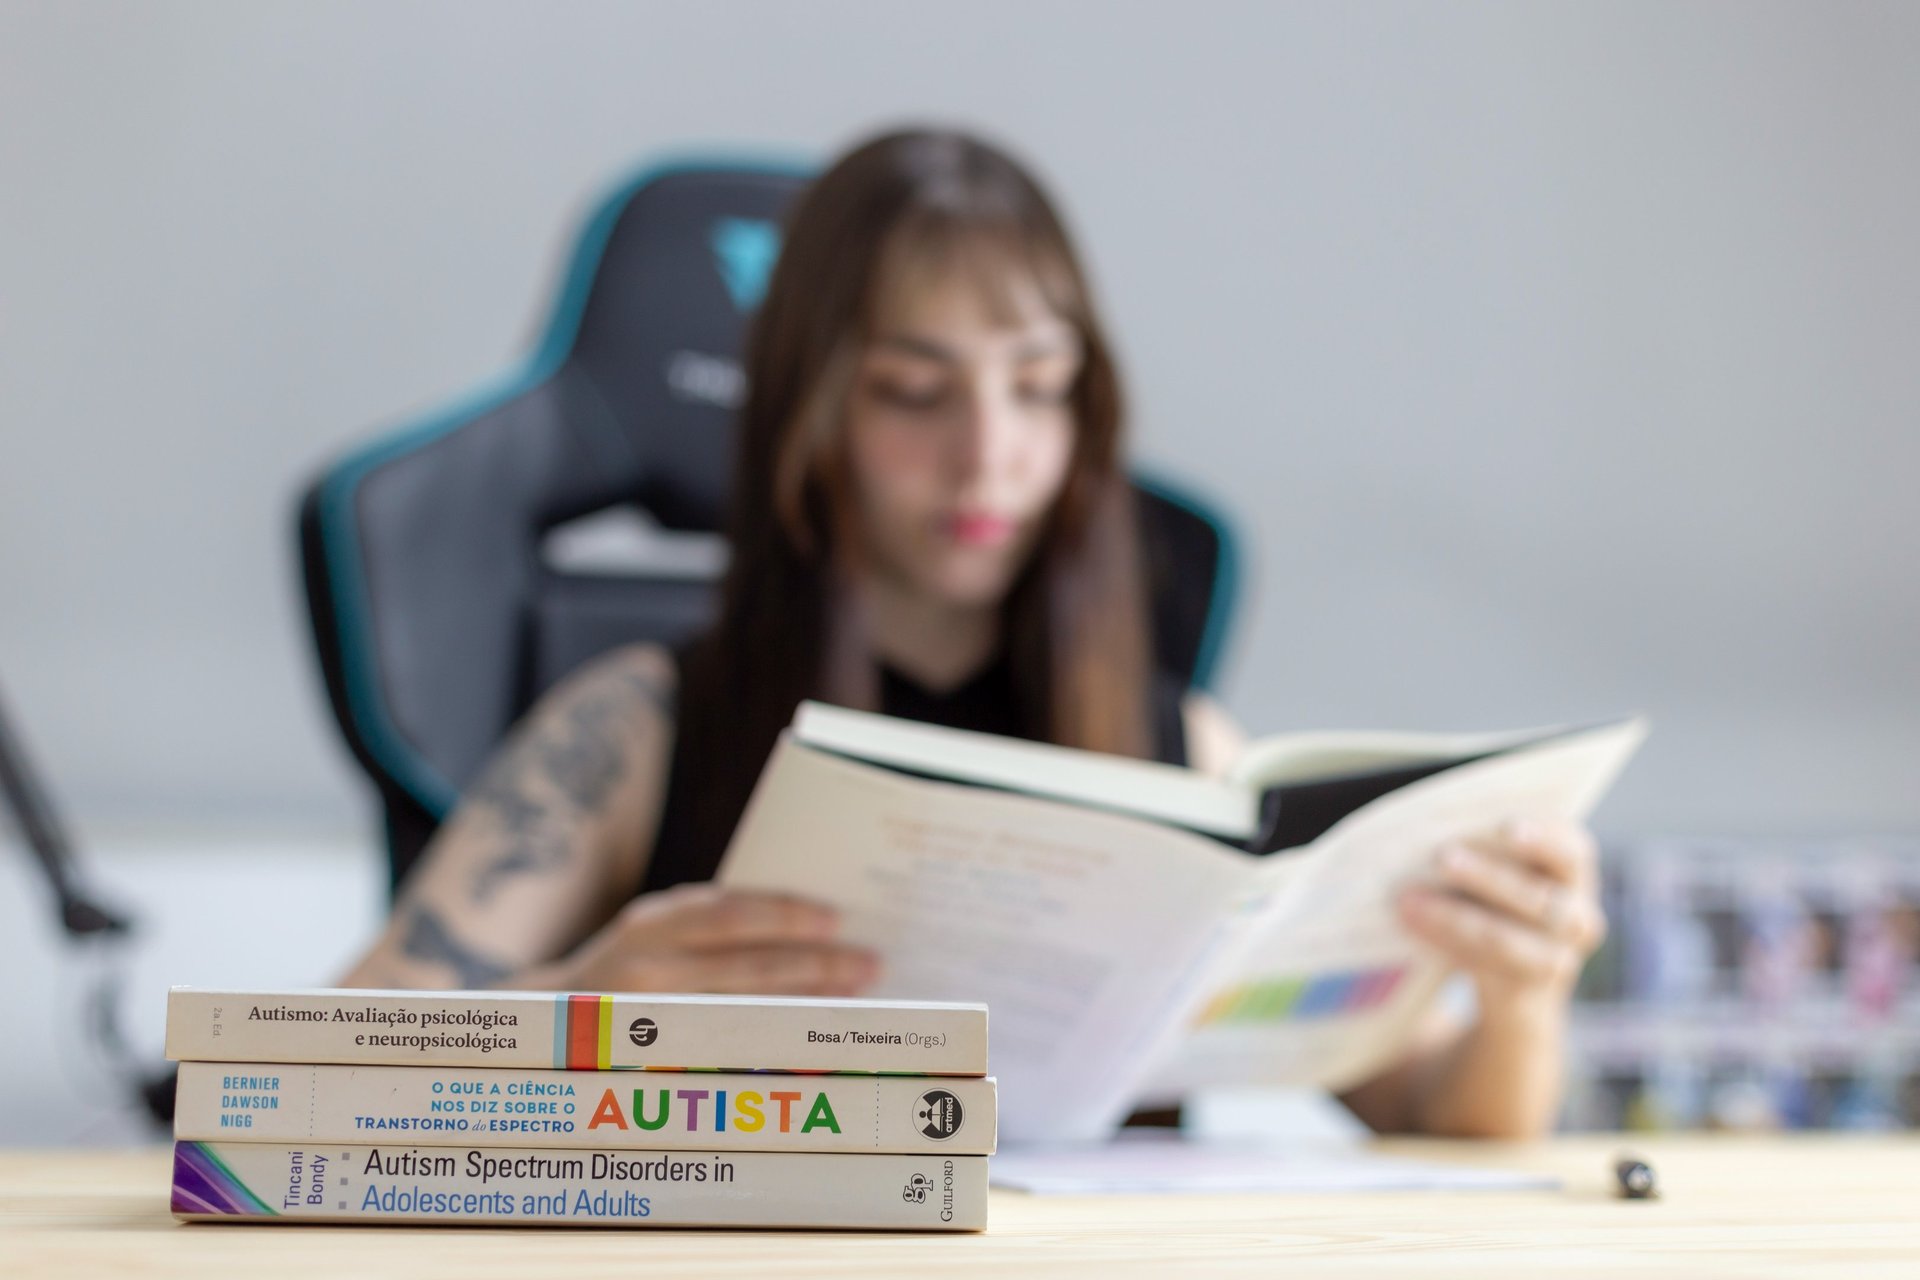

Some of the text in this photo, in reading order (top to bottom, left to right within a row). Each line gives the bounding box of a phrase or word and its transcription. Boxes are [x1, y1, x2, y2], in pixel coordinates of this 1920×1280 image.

[248, 1006, 517, 1029] Autismo: Avaliação psicológica
[355, 1031, 517, 1053] e neuropsicológica
[905, 1033, 946, 1048] (Orgs.)
[223, 1076, 280, 1090] BERNIER
[432, 1080, 575, 1096] O QUE A CIÊNCIA
[222, 1096, 278, 1109] DAWSON
[432, 1101, 575, 1115] NOS DIZ SOBRE O
[587, 1088, 841, 1134] AUTISTA
[221, 1114, 252, 1128] NIGG
[355, 1117, 575, 1133] TRANSTORNO do ESPECTRO
[945, 1097, 953, 1133] artmed
[364, 1149, 734, 1184] Autism Spectrum Disorders in
[284, 1151, 303, 1209] Tincani
[308, 1155, 328, 1205] Bondy
[362, 1185, 651, 1216] Adolescents and Adults
